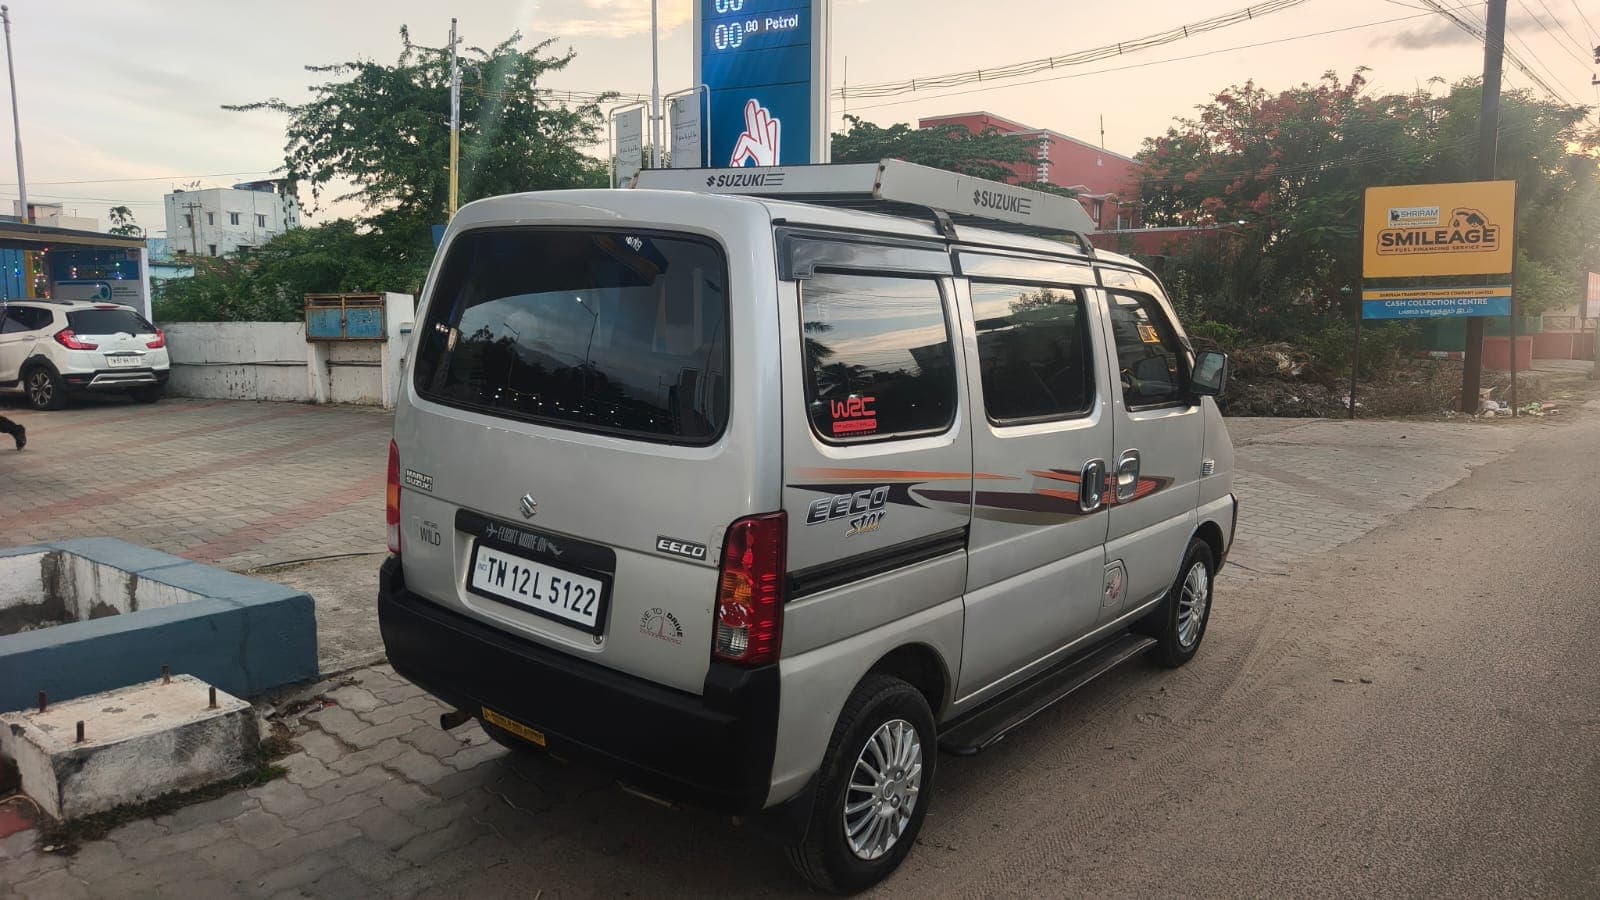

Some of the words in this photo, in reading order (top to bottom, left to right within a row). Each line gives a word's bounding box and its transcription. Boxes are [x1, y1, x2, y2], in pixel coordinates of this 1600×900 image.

[765, 14, 799, 30] Petrol
[716, 174, 766, 187] SUZUKI
[980, 190, 1021, 213] SUZUKI
[1400, 209, 1438, 218] SHRIRAM
[1381, 228, 1496, 247] SMILEAGE
[1407, 299, 1456, 307] COLLECTION
[406, 469, 433, 484] MARUTI
[406, 476, 433, 491] SUZUKI
[806, 485, 891, 526] EECO
[420, 527, 441, 546] WILD
[497, 526, 520, 545] FLIGHT
[518, 533, 538, 551] MODE
[536, 537, 548, 553] ON
[657, 539, 706, 557] EECO
[487, 557, 508, 588] TN
[548, 576, 597, 617] 5122
[640, 610, 652, 628] LIVE
[650, 607, 663, 615] TO
[666, 612, 683, 638] DRIVE
